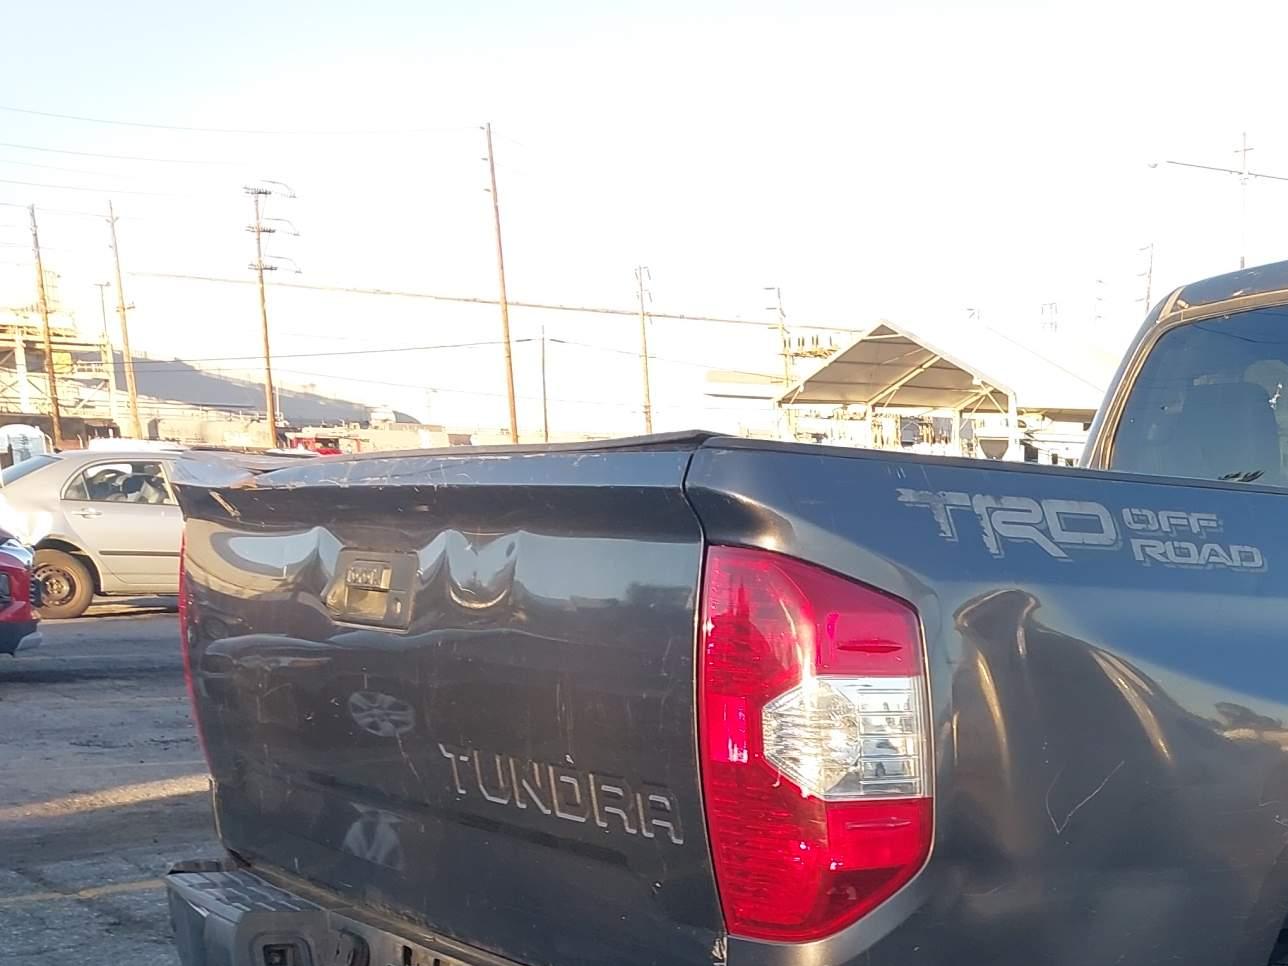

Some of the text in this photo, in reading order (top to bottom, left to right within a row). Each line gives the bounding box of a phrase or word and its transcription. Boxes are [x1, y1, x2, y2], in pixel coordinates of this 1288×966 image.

[896, 488, 1224, 561] TRD OFF
[1129, 538, 1268, 572] ROAD
[438, 743, 684, 845] TUNDRA
